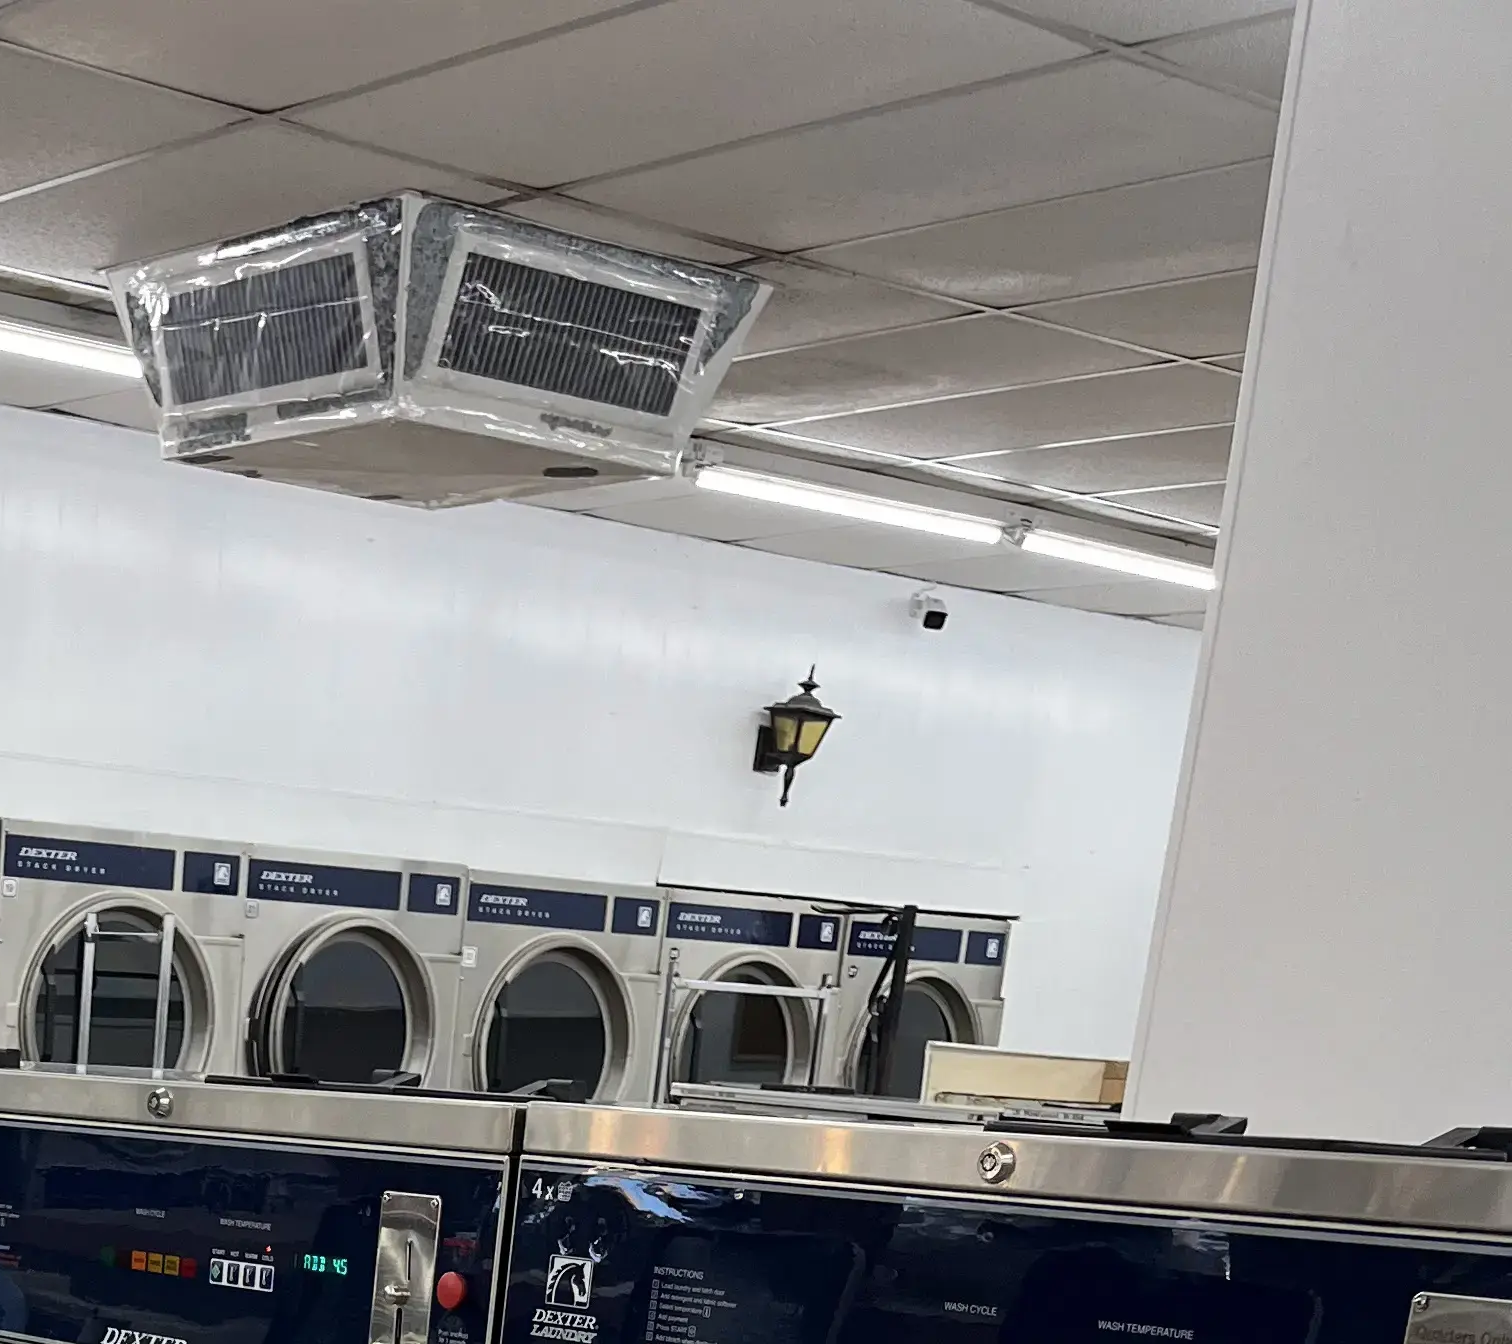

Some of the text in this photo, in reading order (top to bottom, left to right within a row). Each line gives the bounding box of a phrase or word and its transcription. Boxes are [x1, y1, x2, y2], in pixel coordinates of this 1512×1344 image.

[18, 846, 78, 861] DEXTER
[531, 1177, 543, 1201] 4
[332, 1258, 348, 1275] 45
[653, 1266, 704, 1280] INSTRUCTIONS
[943, 1301, 998, 1317] WASH CYCLE
[531, 1308, 597, 1330] DEXTER
[530, 1323, 598, 1344] LAUNDRY
[1097, 1319, 1194, 1341] WASH TEMPERATURE
